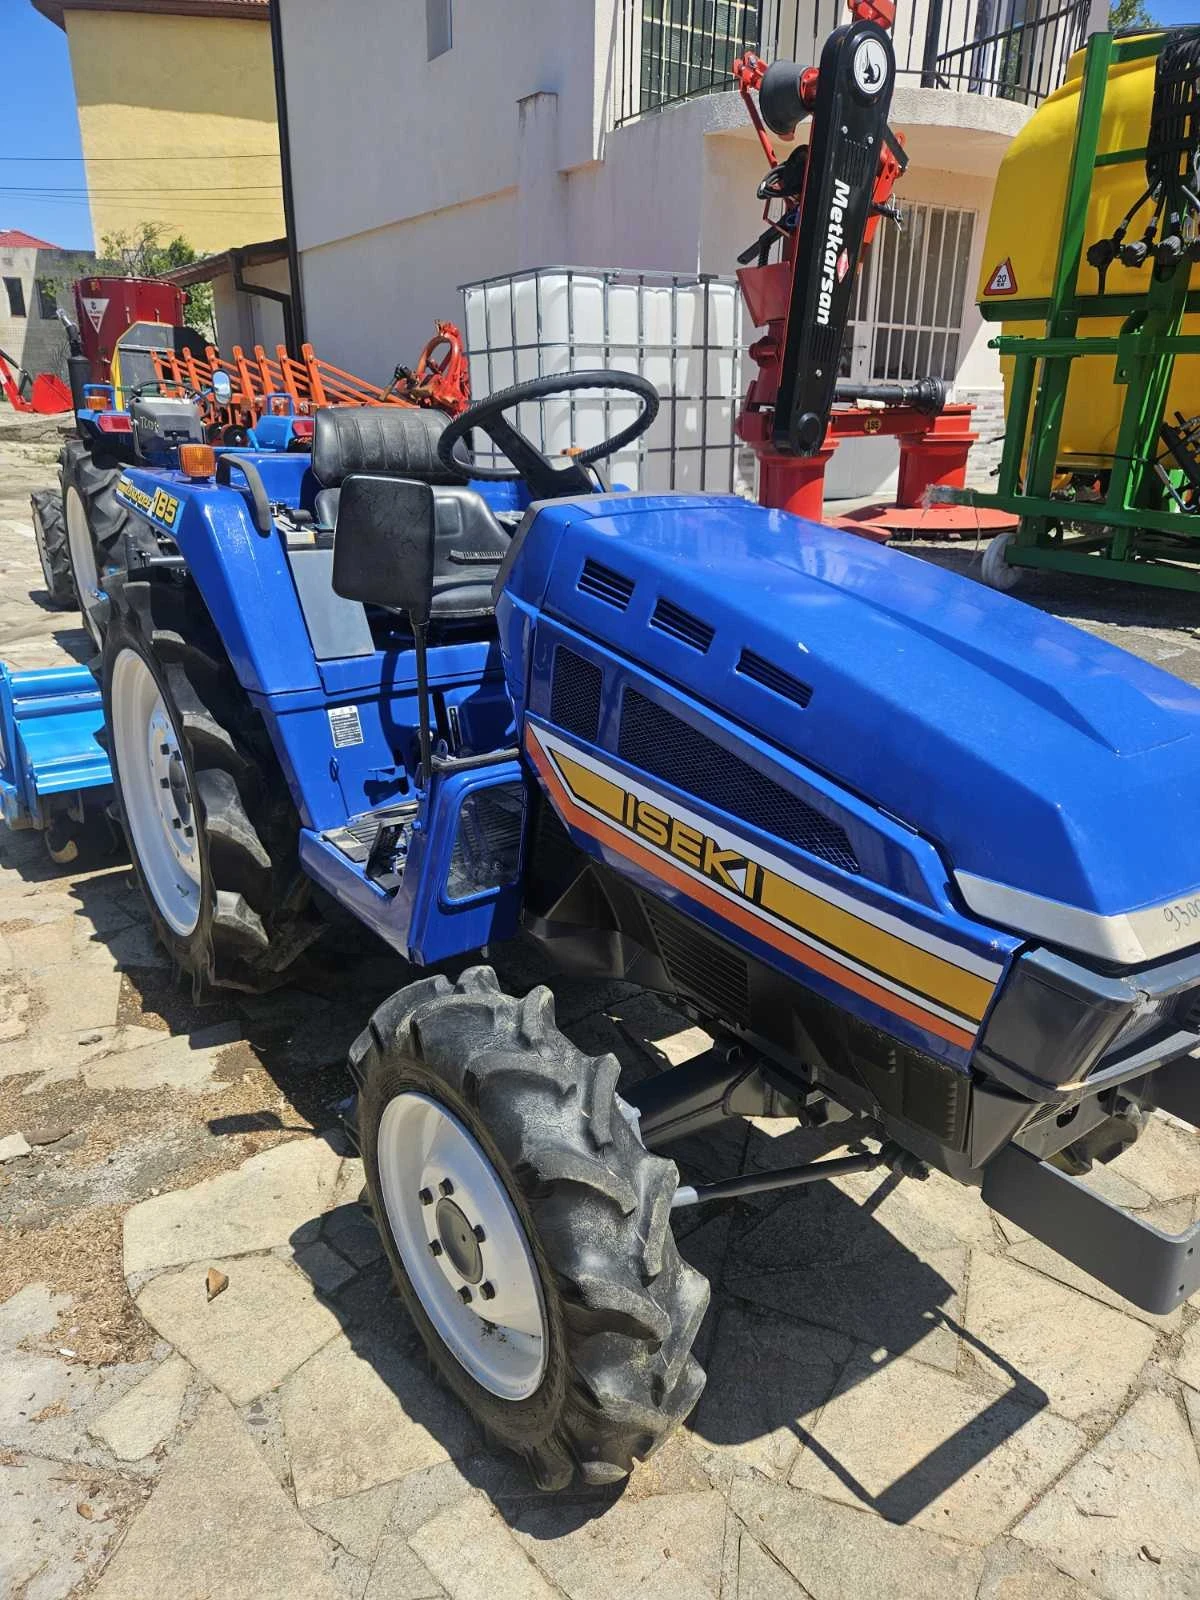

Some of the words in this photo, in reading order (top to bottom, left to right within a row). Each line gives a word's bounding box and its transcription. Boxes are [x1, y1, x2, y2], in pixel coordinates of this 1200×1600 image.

[816, 178, 850, 325] Metkarsan
[997, 274, 1007, 282] 20
[151, 489, 179, 526] 185
[626, 791, 758, 902] ISEKI
